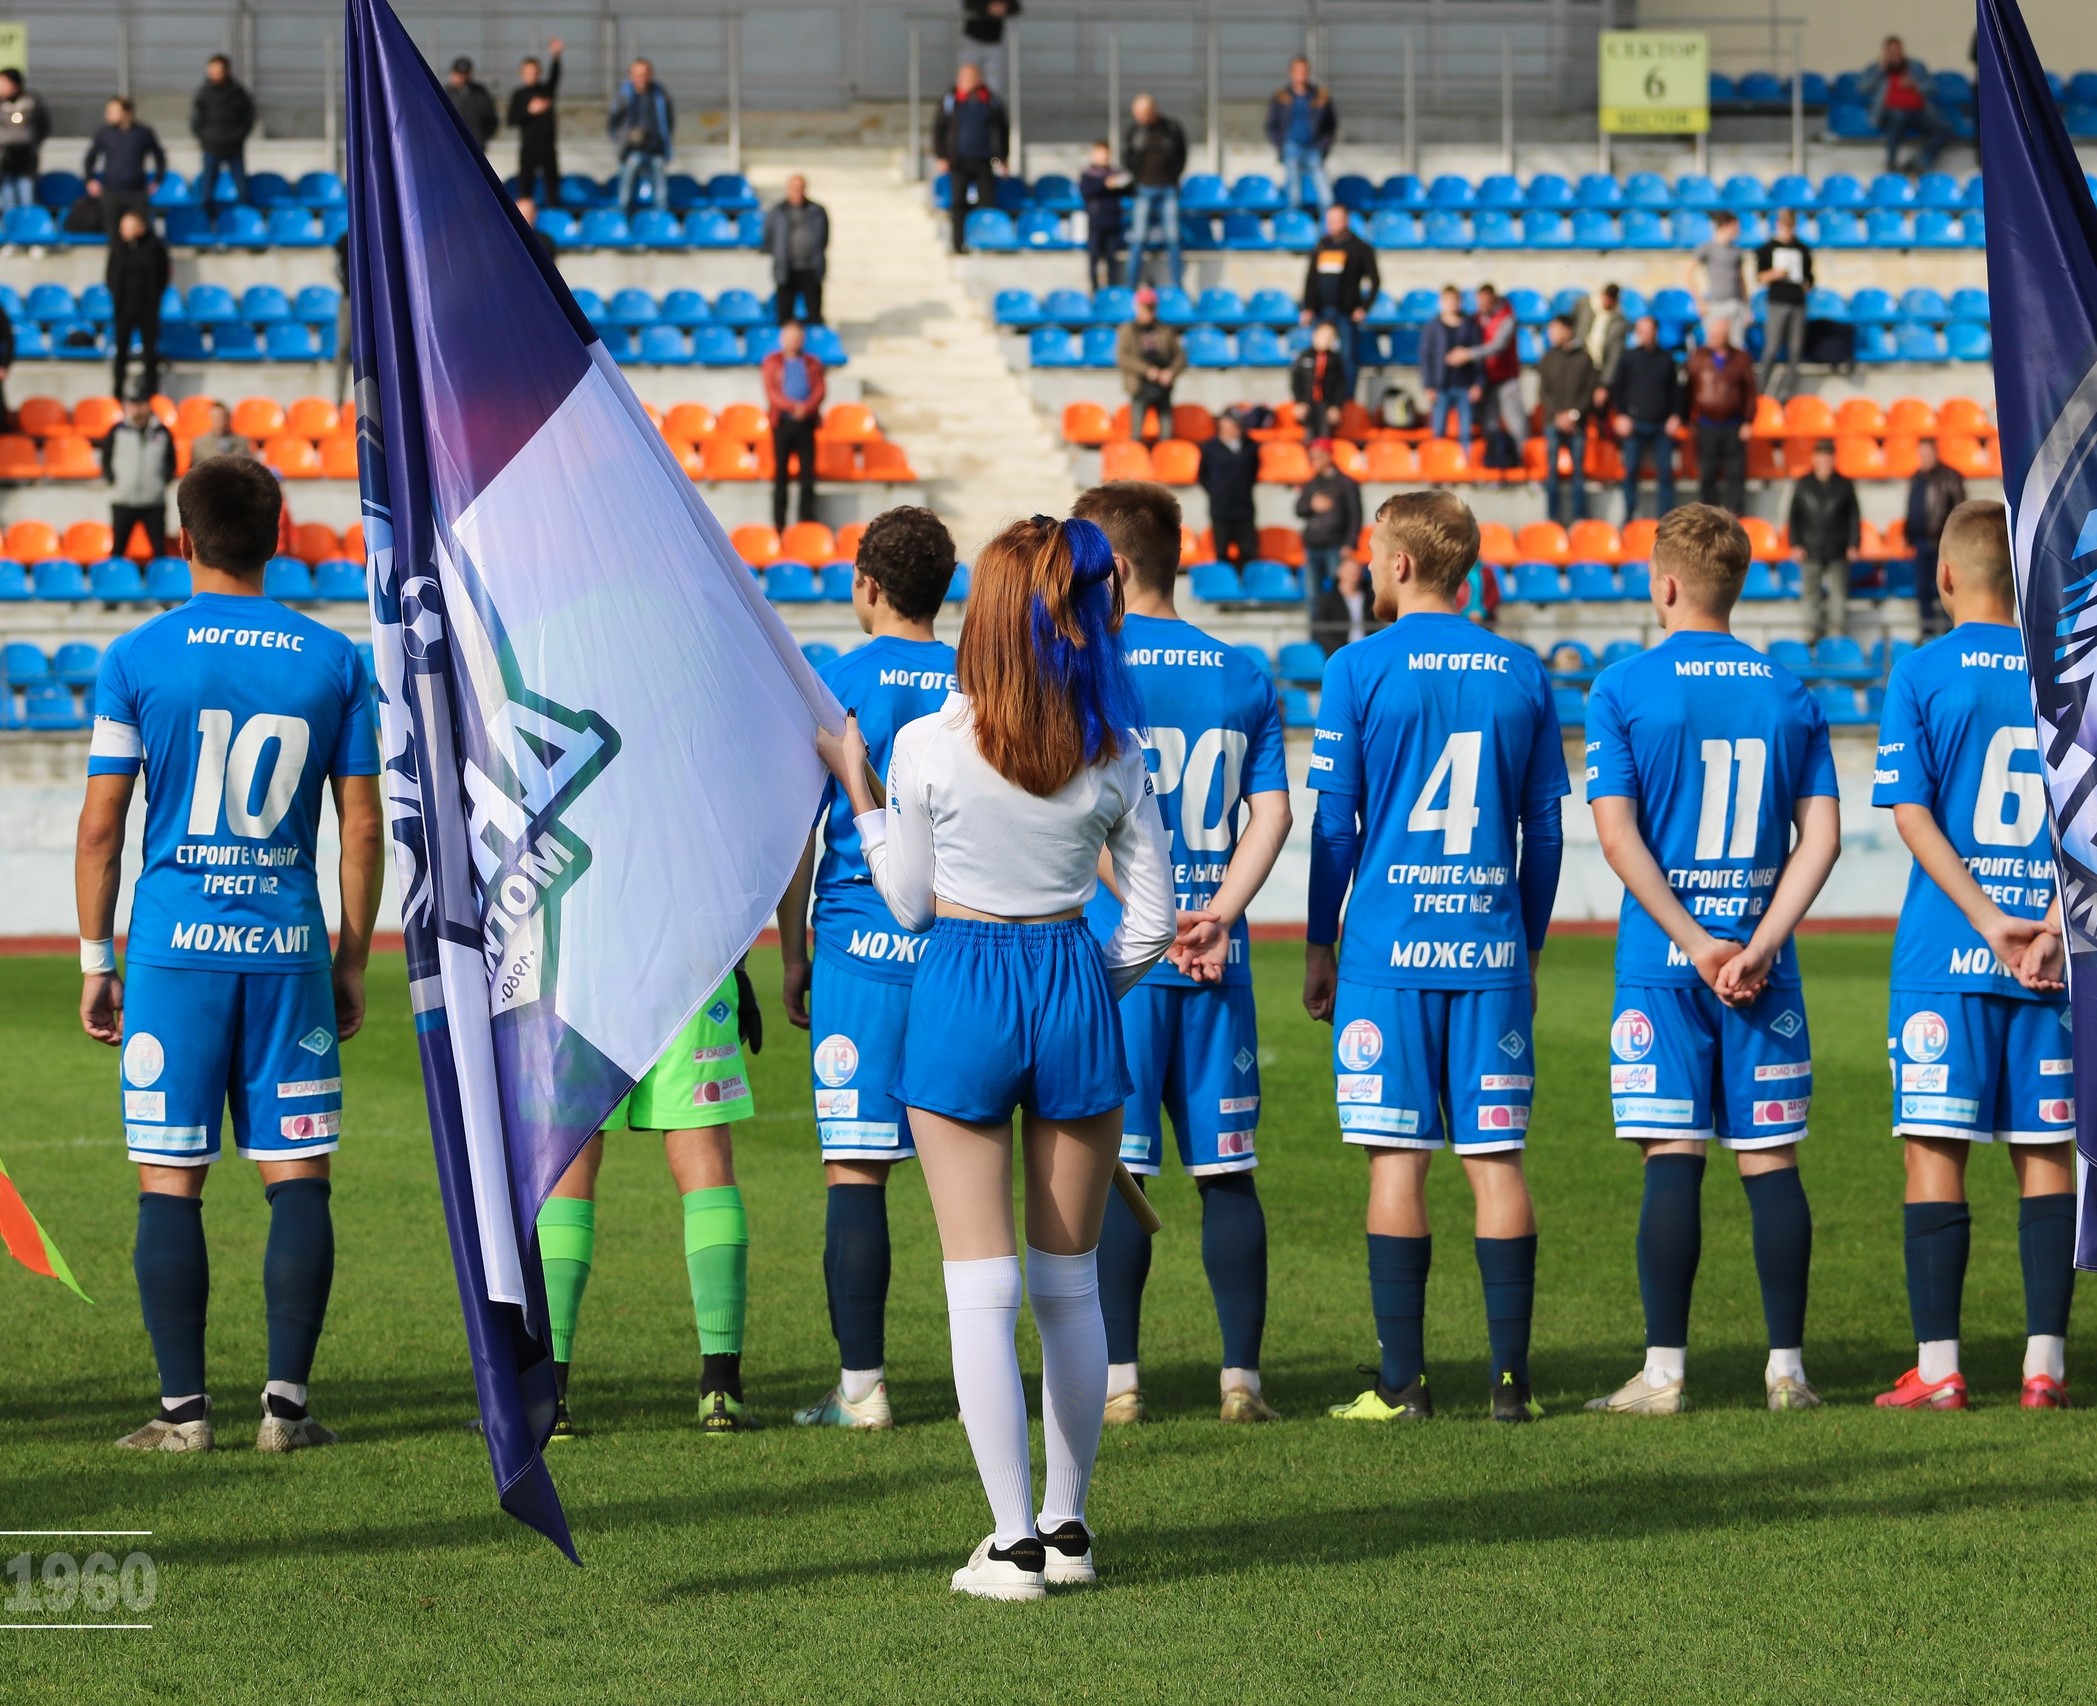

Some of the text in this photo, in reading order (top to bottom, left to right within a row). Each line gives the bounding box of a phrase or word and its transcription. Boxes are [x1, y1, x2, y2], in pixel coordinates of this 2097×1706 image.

[1643, 64, 1666, 102] 6
[187, 627, 304, 652] МОГОТЕКС
[1409, 653, 1509, 673] МОГОТЕКС
[1675, 661, 1773, 679] МОГОТЕКС
[1961, 652, 2026, 671] МОГОТ
[880, 669, 957, 690] МОГОТЕ
[187, 708, 310, 839] 10
[1407, 731, 1482, 855] 4
[1973, 725, 2047, 847] 6
[1694, 738, 1766, 861] 11
[176, 843, 299, 867] СТРОИТЕЛЬНЫЙ
[203, 873, 256, 895] ТРЕСТ
[1981, 884, 2024, 906] РЕСТ
[1413, 894, 1467, 913] ТРЕСТ
[1694, 896, 1748, 916] ТРЕСТ
[170, 921, 310, 953] МОЖЕЛИТ
[1390, 941, 1516, 968] МОЖЕЛИТ
[707, 1418, 732, 1426] COPA
